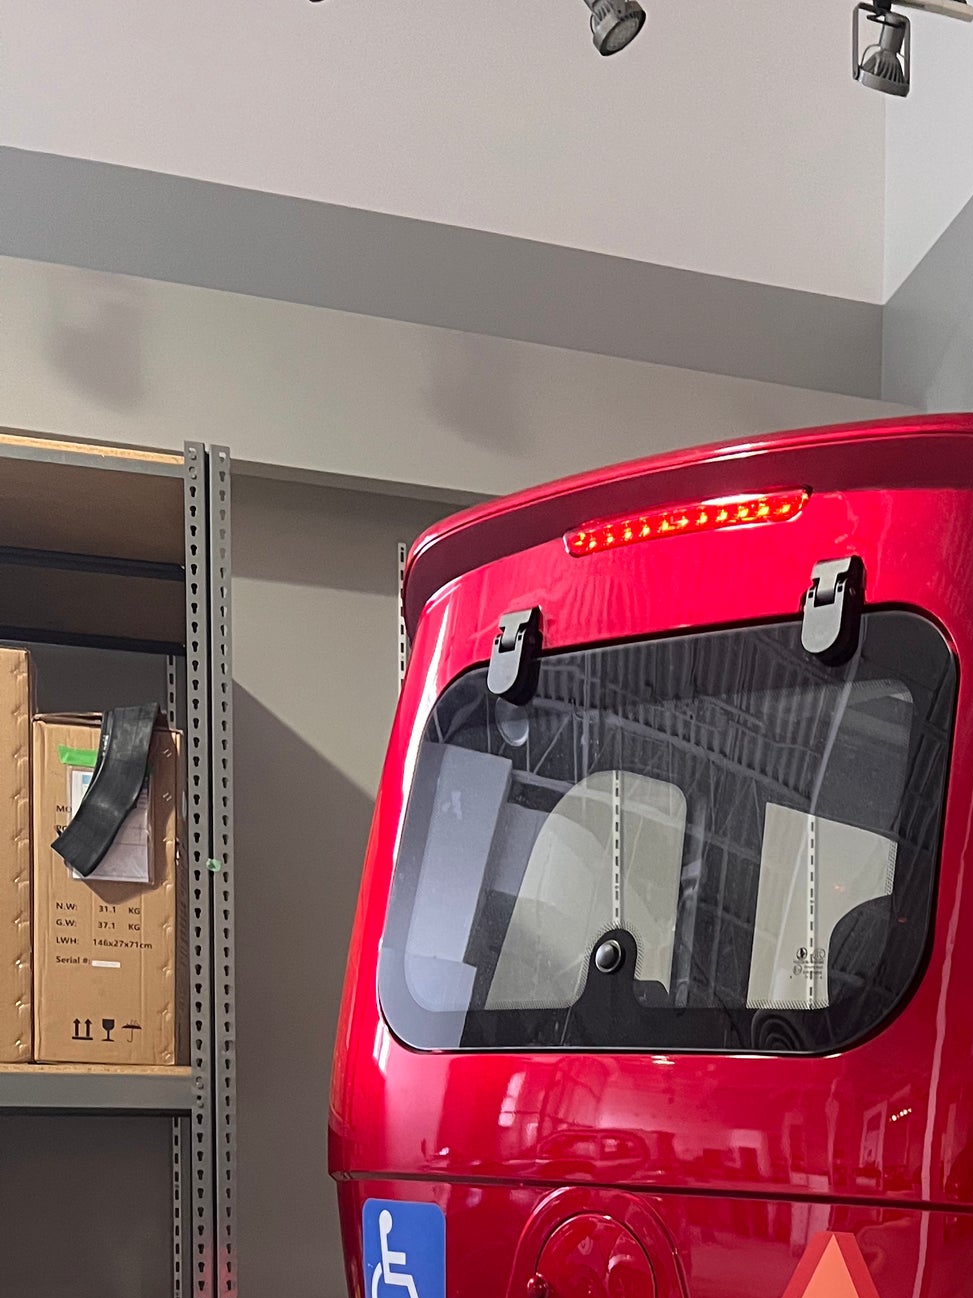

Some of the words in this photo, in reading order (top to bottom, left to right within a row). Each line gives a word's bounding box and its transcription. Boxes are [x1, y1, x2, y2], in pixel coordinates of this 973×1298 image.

[99, 905, 116, 914] 31.1
[128, 907, 141, 915] KG
[98, 921, 115, 930] 37.1
[56, 955, 80, 964] Serial
